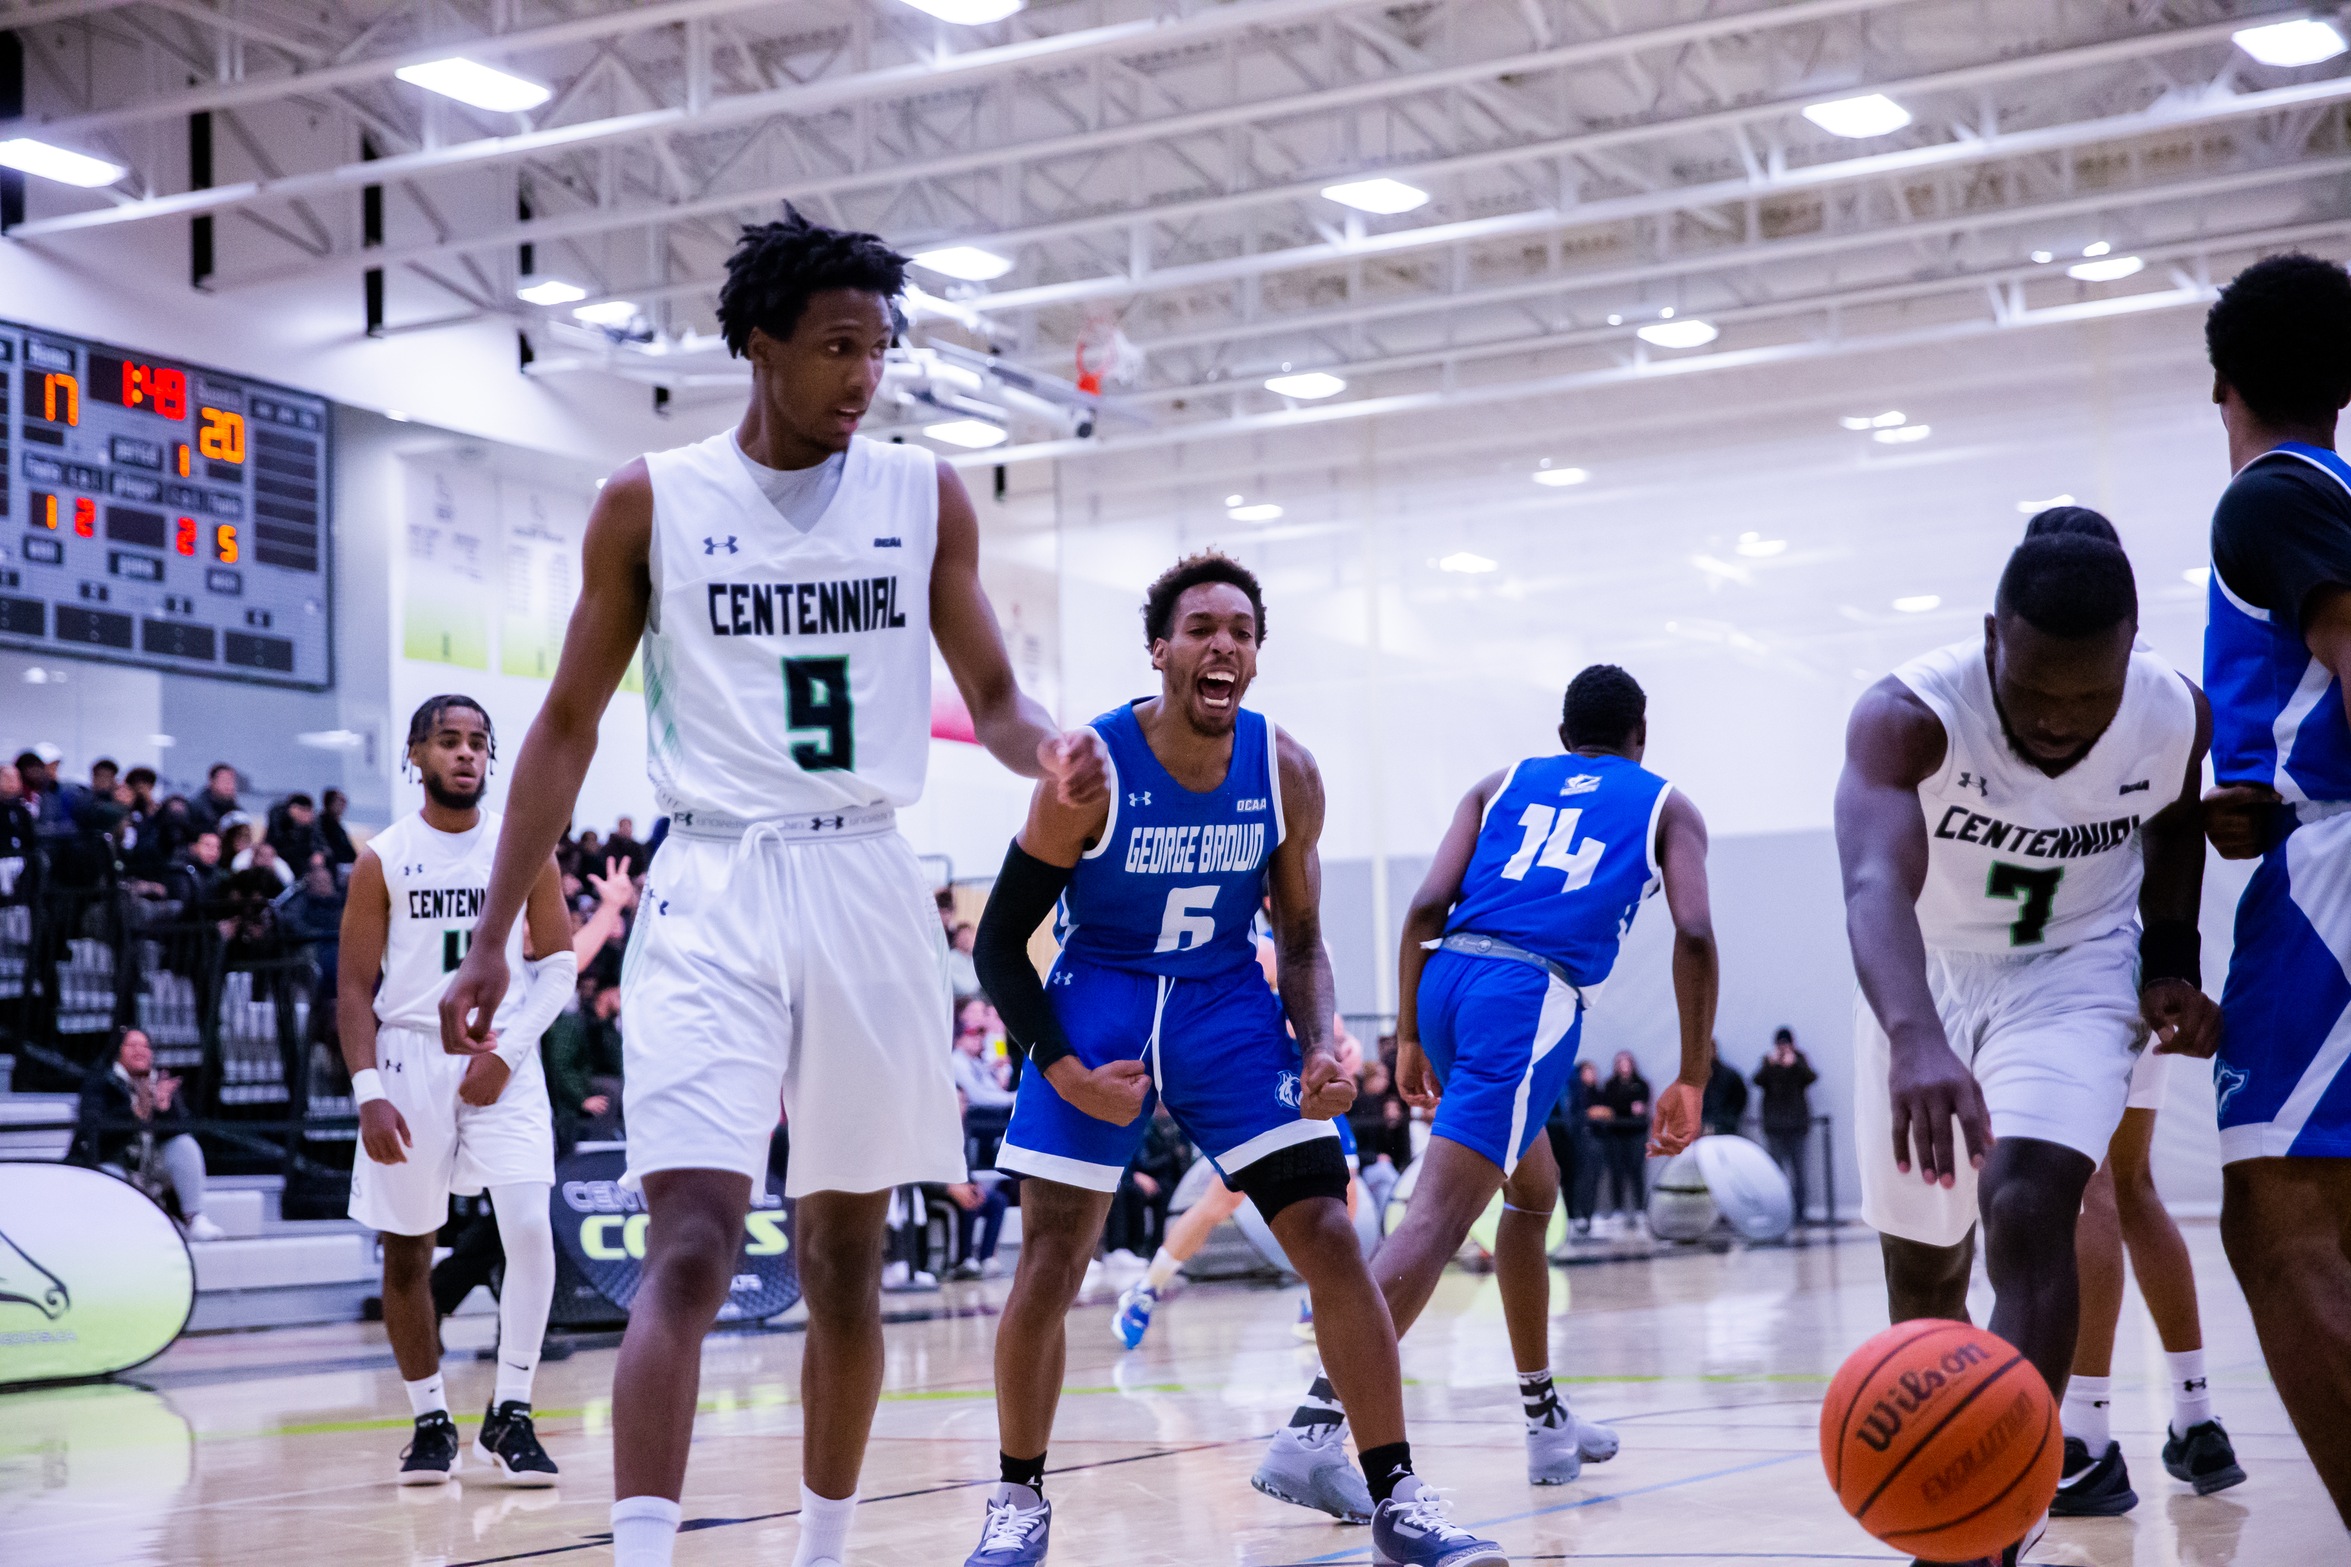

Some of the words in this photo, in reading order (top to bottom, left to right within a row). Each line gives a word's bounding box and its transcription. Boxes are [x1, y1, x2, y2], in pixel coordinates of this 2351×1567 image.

[45, 373, 78, 426] 17
[122, 360, 187, 421] 1:49
[200, 407, 245, 464] 20
[75, 497, 95, 537] 2
[176, 517, 197, 556] 2
[217, 524, 238, 563] 5
[708, 575, 906, 636] CENTENNIAL
[780, 654, 855, 773] 9
[1236, 798, 1267, 812] OCAA
[1125, 826, 1201, 874] GEORGE
[1198, 823, 1265, 873] BROWN
[1500, 803, 1607, 894] 14
[1153, 885, 1221, 953] 6
[1984, 860, 2065, 947] 7
[1856, 1343, 1991, 1452] Wilson
[1920, 1389, 2035, 1504] EVOLUTION
